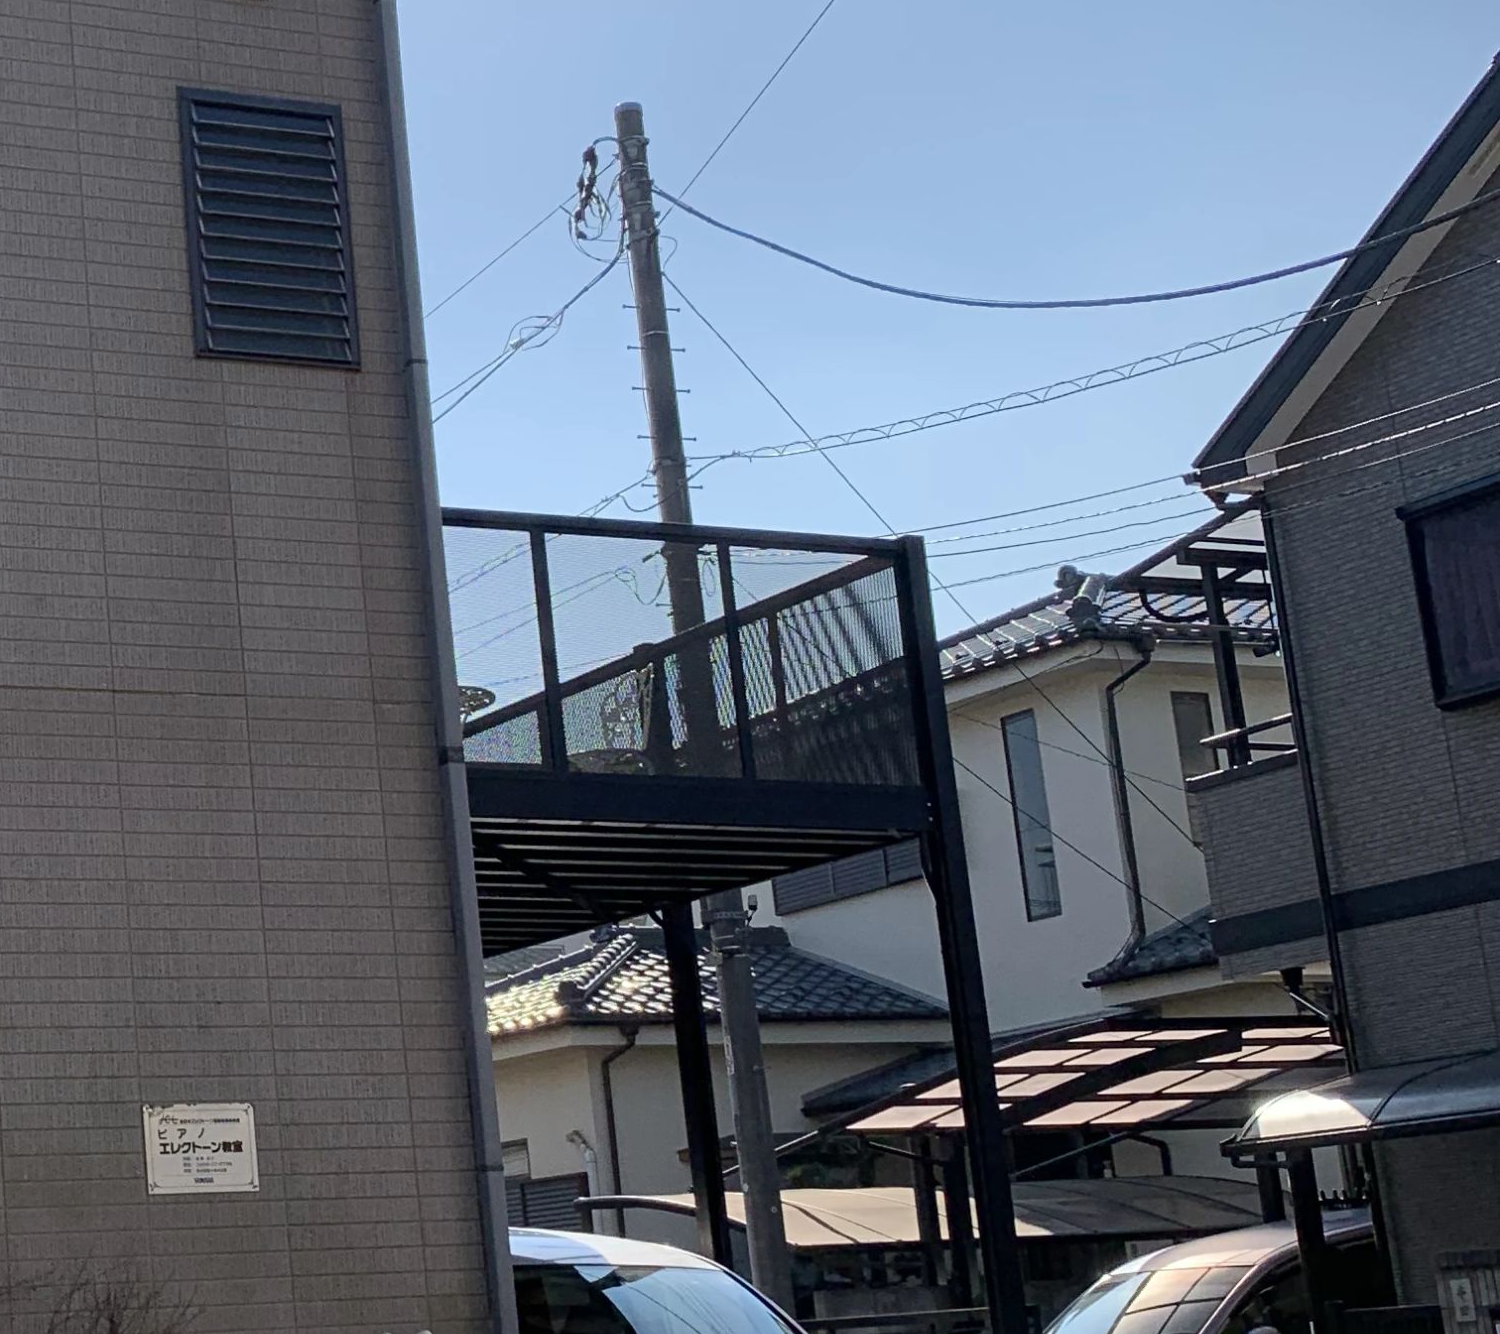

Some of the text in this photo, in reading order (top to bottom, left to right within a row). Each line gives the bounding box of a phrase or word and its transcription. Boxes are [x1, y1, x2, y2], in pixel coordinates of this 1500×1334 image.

[159, 1140, 244, 1155] エレクトーン教室
